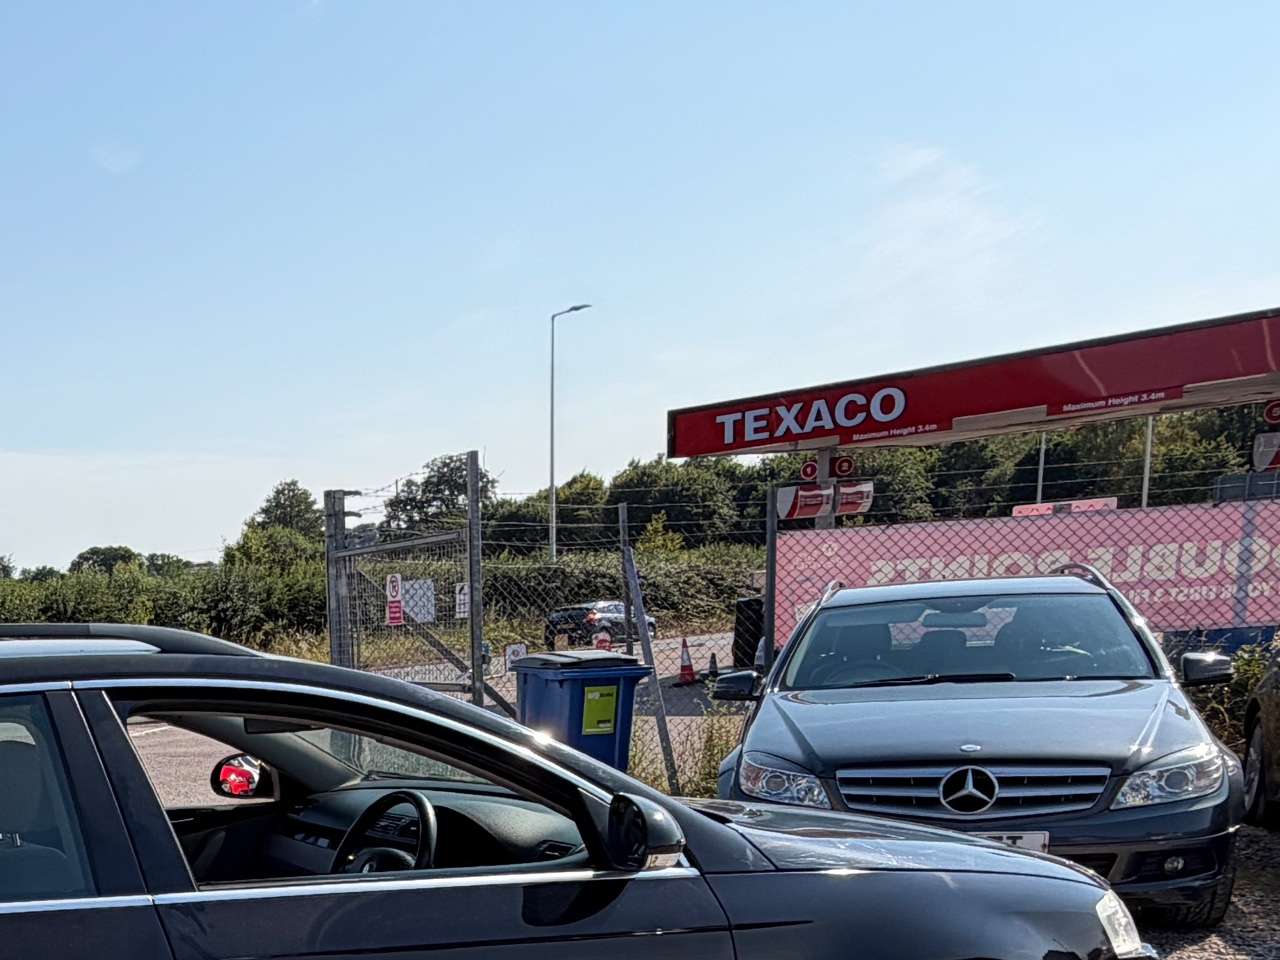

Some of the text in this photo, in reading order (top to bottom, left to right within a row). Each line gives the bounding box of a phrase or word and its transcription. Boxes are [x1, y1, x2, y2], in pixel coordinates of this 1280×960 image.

[1062, 391, 1165, 412] Maximum Height 3.4m
[716, 387, 906, 444] TEXACO
[852, 424, 938, 441] Maximum Height 3.4m
